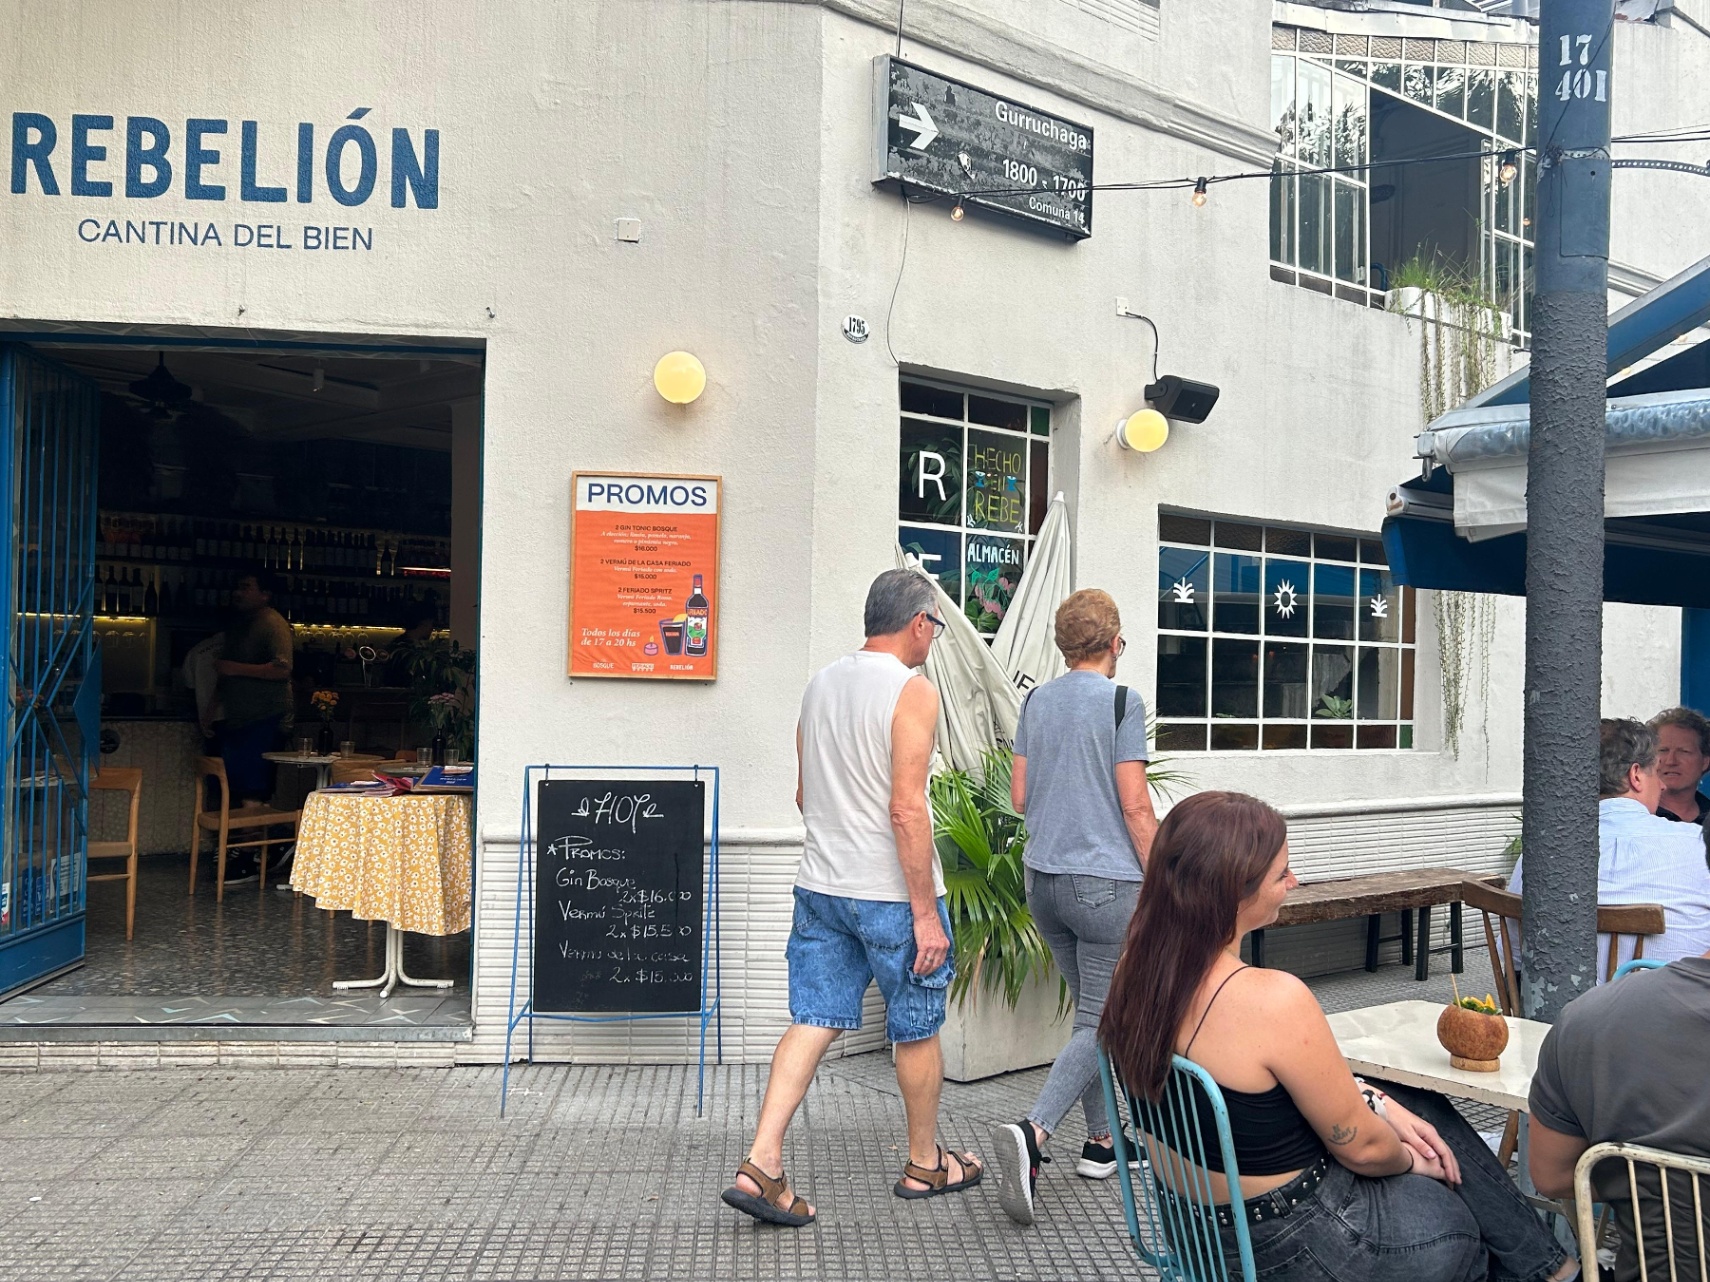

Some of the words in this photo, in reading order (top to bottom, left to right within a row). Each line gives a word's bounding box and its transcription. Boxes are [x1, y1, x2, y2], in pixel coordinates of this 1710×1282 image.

[1559, 34, 1592, 66] 17
[1555, 69, 1607, 102] 401
[995, 101, 1088, 150] Gurruchaga
[10, 107, 440, 210] REBELIÓN
[1002, 159, 1038, 187] 1800
[1053, 175, 1086, 202] 1700
[1028, 197, 1071, 220] Comuna
[1073, 210, 1086, 225] 14
[77, 218, 222, 247] CANTINA
[234, 223, 292, 250] DEL
[303, 226, 373, 251] BIEN
[974, 446, 1022, 475] HECHO
[587, 482, 708, 507] PROMOS
[974, 489, 1021, 524] REBE
[967, 542, 1020, 565] ALMACÉN
[580, 638, 592, 646] de
[613, 639, 625, 647] 20
[626, 639, 636, 647] hs
[581, 628, 606, 637] Todos
[608, 628, 620, 637] los
[622, 629, 640, 638] días
[556, 867, 583, 887] Gin
